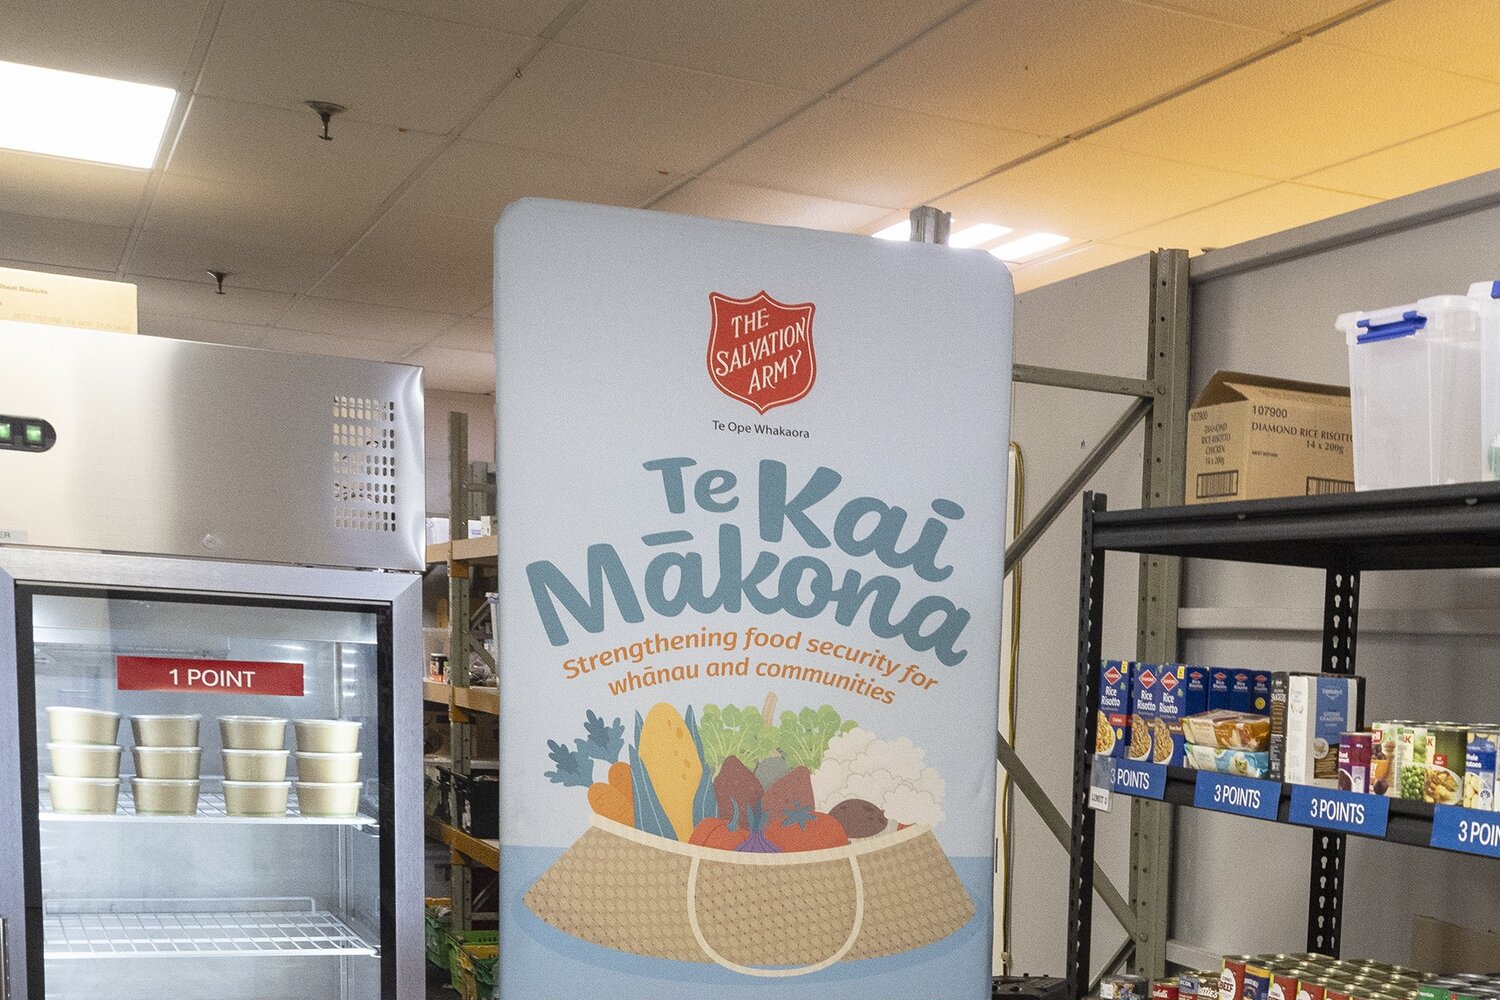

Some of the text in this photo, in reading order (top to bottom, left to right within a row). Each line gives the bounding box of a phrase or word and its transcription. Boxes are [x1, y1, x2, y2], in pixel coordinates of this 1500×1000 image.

[731, 308, 769, 338] THE
[716, 317, 805, 376] SALVATION
[748, 349, 802, 395] ARMY
[1252, 405, 1288, 418] 107900
[713, 420, 809, 438] Te Ope Whakaora
[1252, 422, 1297, 436] DIAMOND
[1300, 428, 1318, 438] RICE
[1306, 440, 1315, 449] 14
[1325, 443, 1344, 454] 200g
[643, 457, 966, 583] Te Kai
[525, 523, 971, 667] Mākona
[562, 626, 938, 690] Strengthening food security for
[169, 668, 256, 688] 1 POINT
[608, 657, 896, 705] whānau and communities
[1102, 695, 1120, 707] Risotto
[1105, 686, 1117, 696] Rice
[1110, 768, 1149, 789] 3 POINTS
[1214, 785, 1261, 809] 3 POINTS
[1310, 799, 1365, 825] 3 POINTS
[1458, 821, 1467, 841] 3
